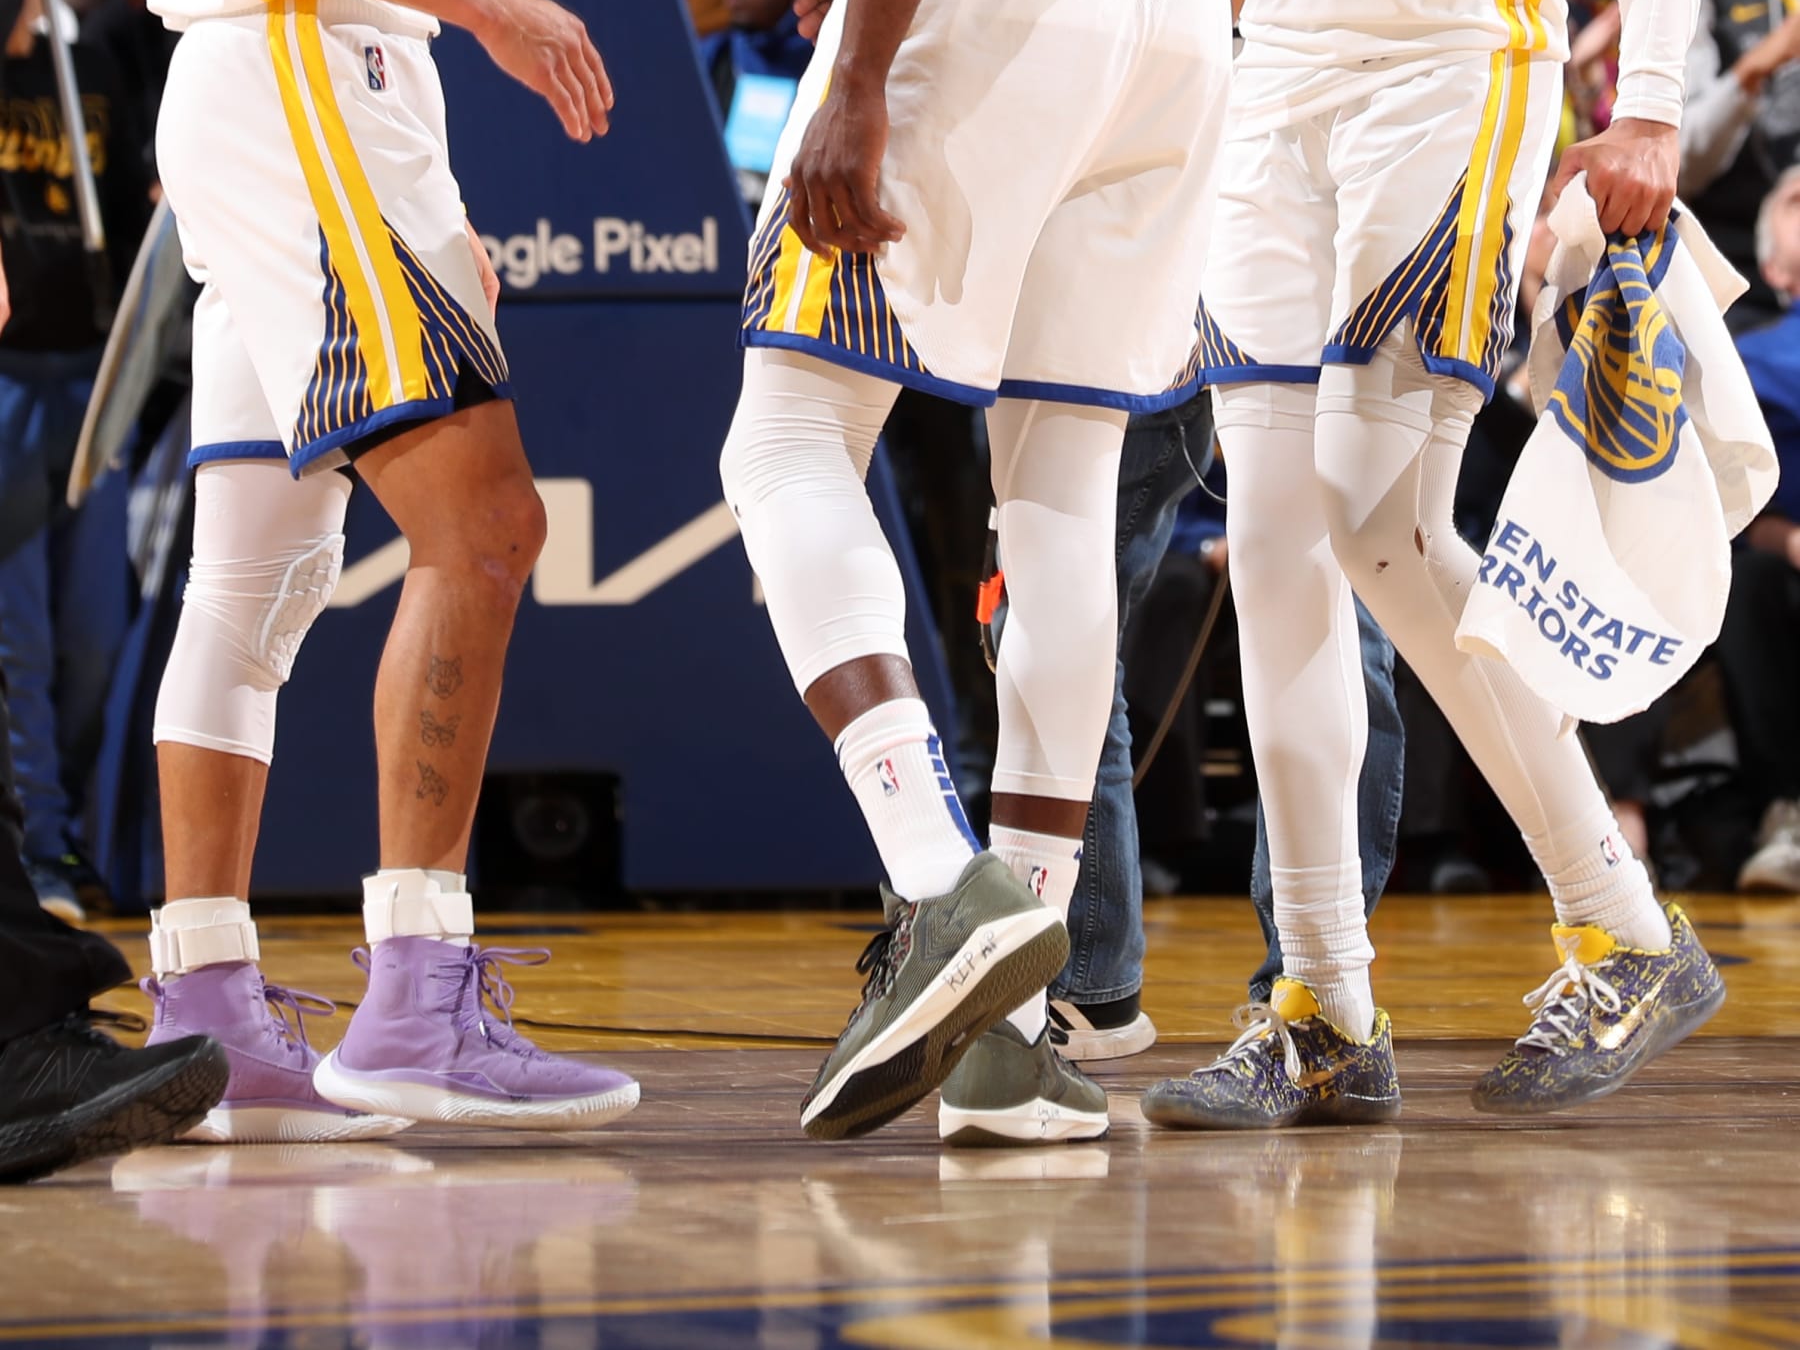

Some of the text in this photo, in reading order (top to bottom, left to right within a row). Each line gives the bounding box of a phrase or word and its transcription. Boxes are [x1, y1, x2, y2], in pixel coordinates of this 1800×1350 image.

[594, 217, 718, 273] Pixel
[1490, 519, 1684, 665] EN STATE
[943, 952, 978, 992] RIP
